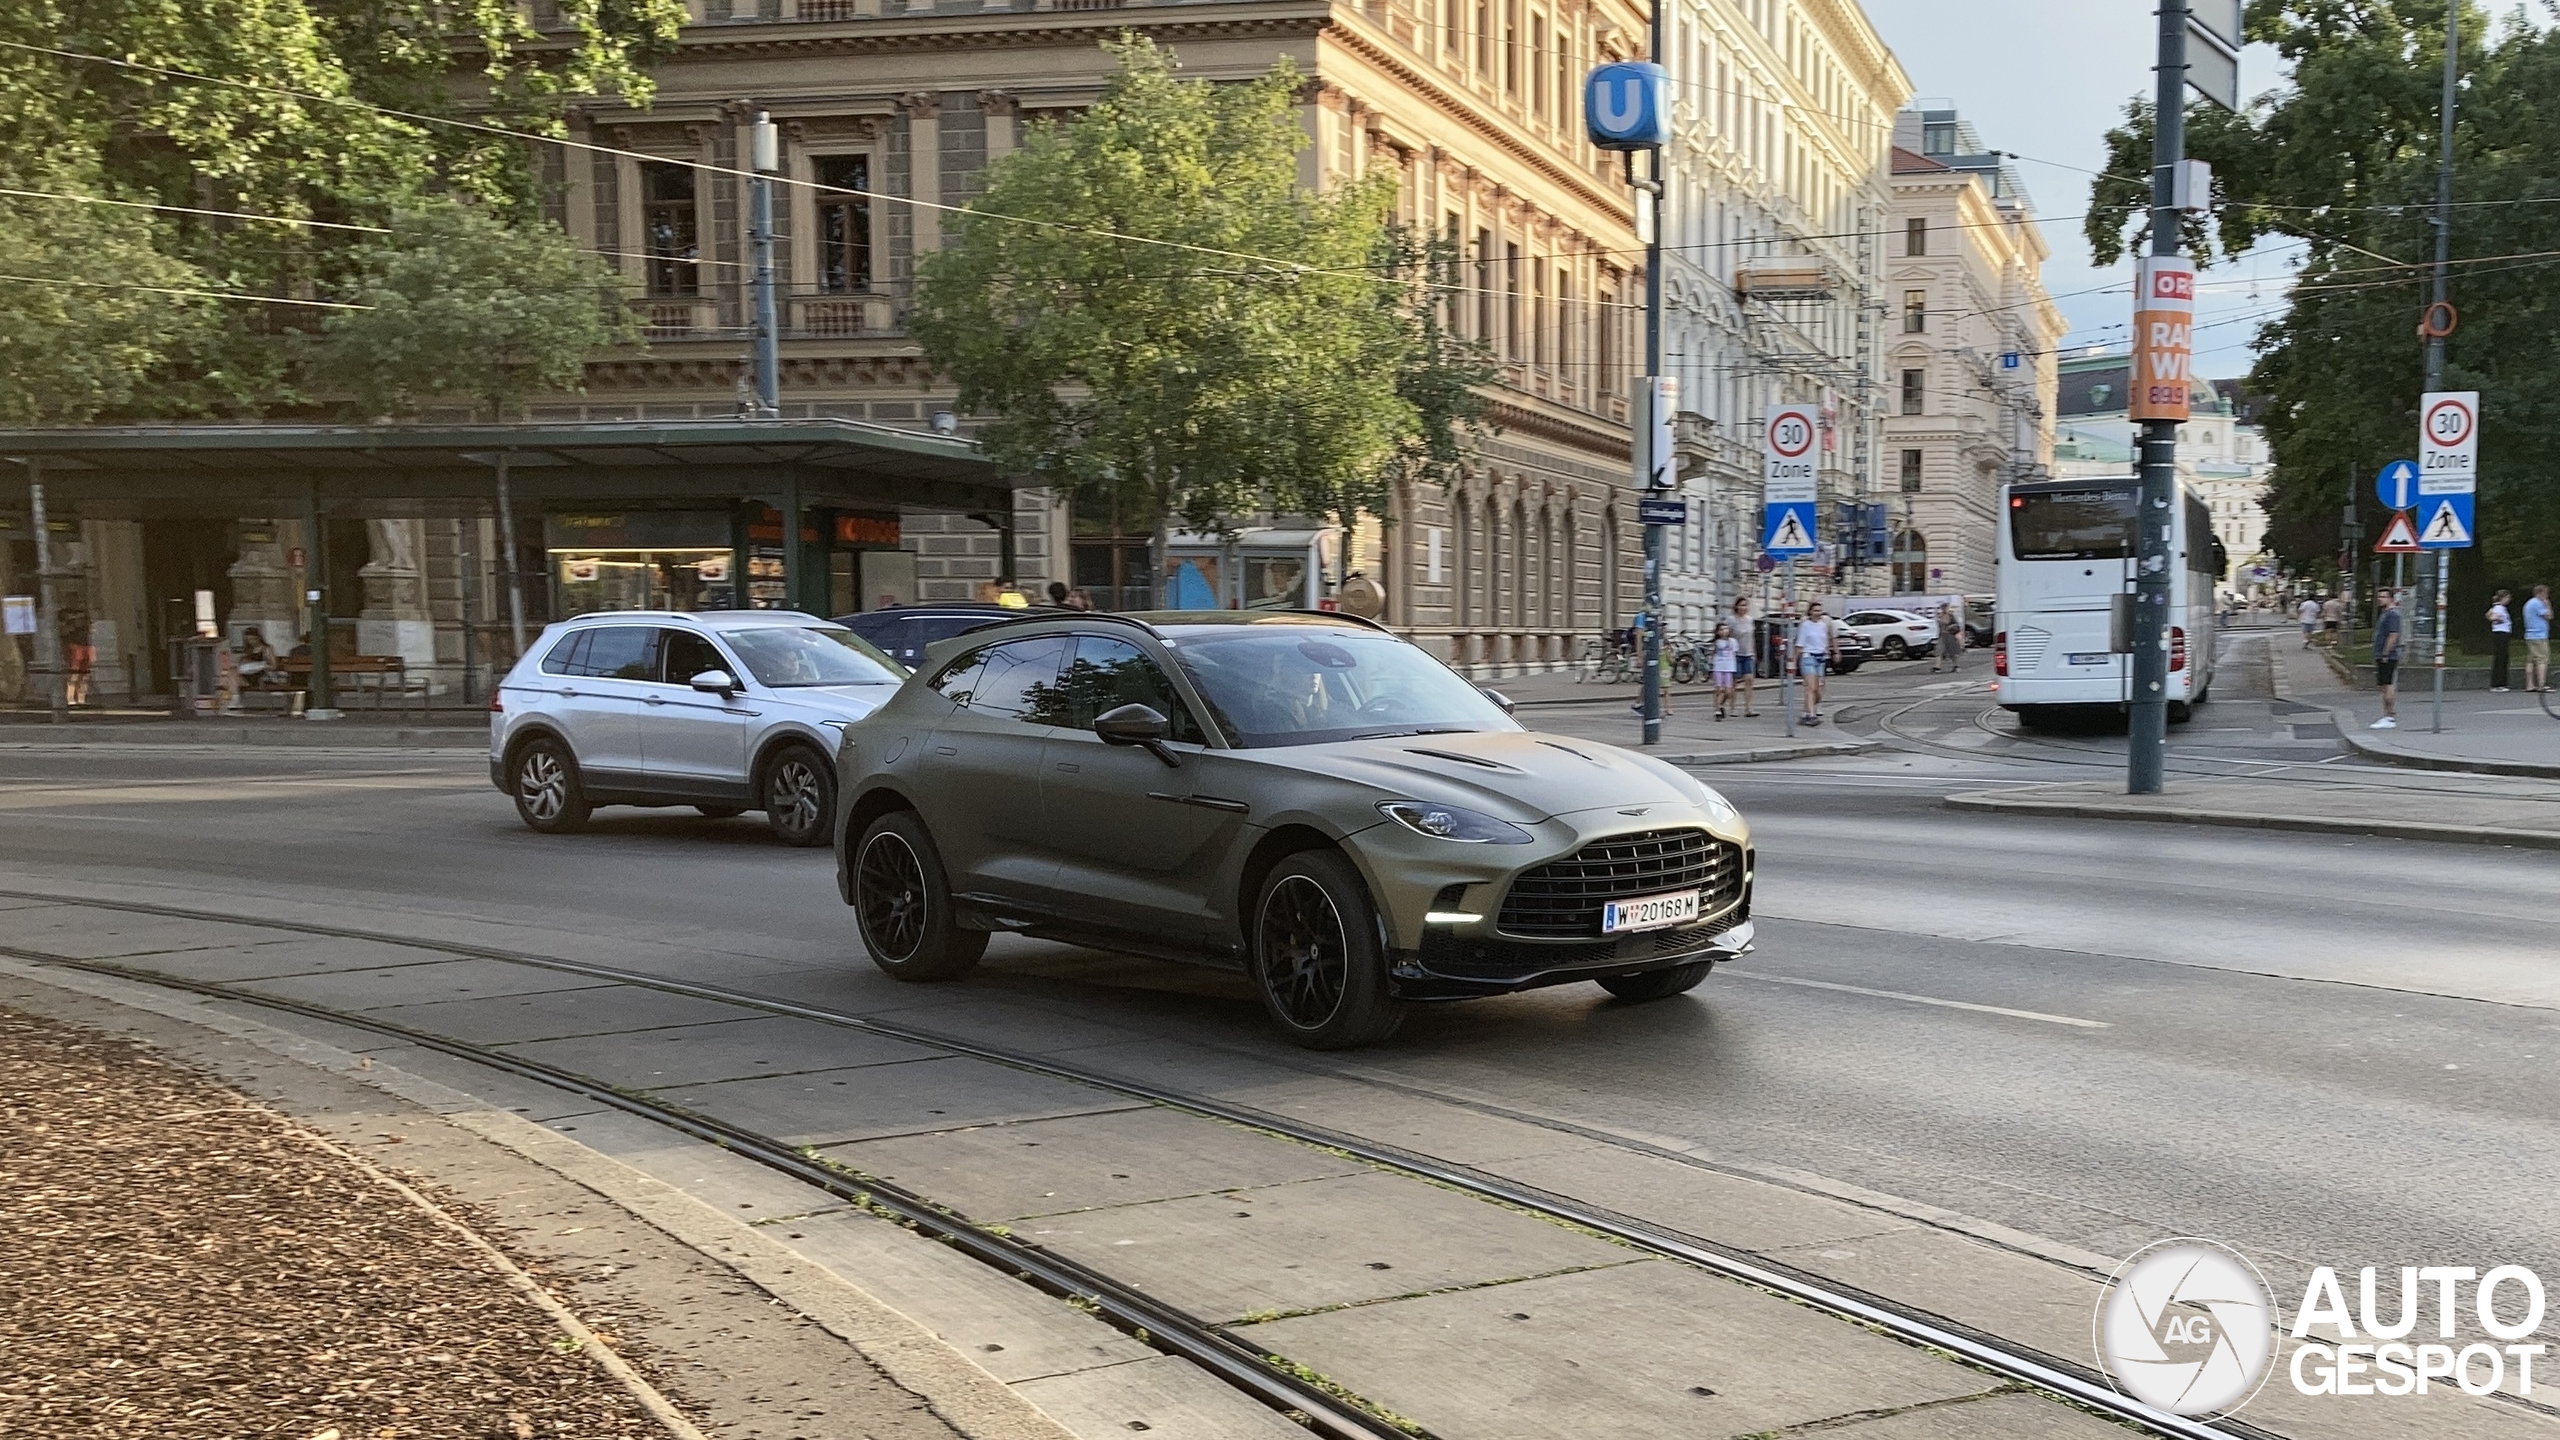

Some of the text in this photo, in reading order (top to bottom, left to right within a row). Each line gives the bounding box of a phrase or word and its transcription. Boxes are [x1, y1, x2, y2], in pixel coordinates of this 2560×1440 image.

[1594, 79, 1642, 132] U
[2437, 413, 2461, 434] 30
[1781, 424, 1803, 445] 30
[1772, 461, 1812, 478] Zone
[2426, 451, 2470, 469] Zone
[1618, 896, 1694, 925] W 20168 M
